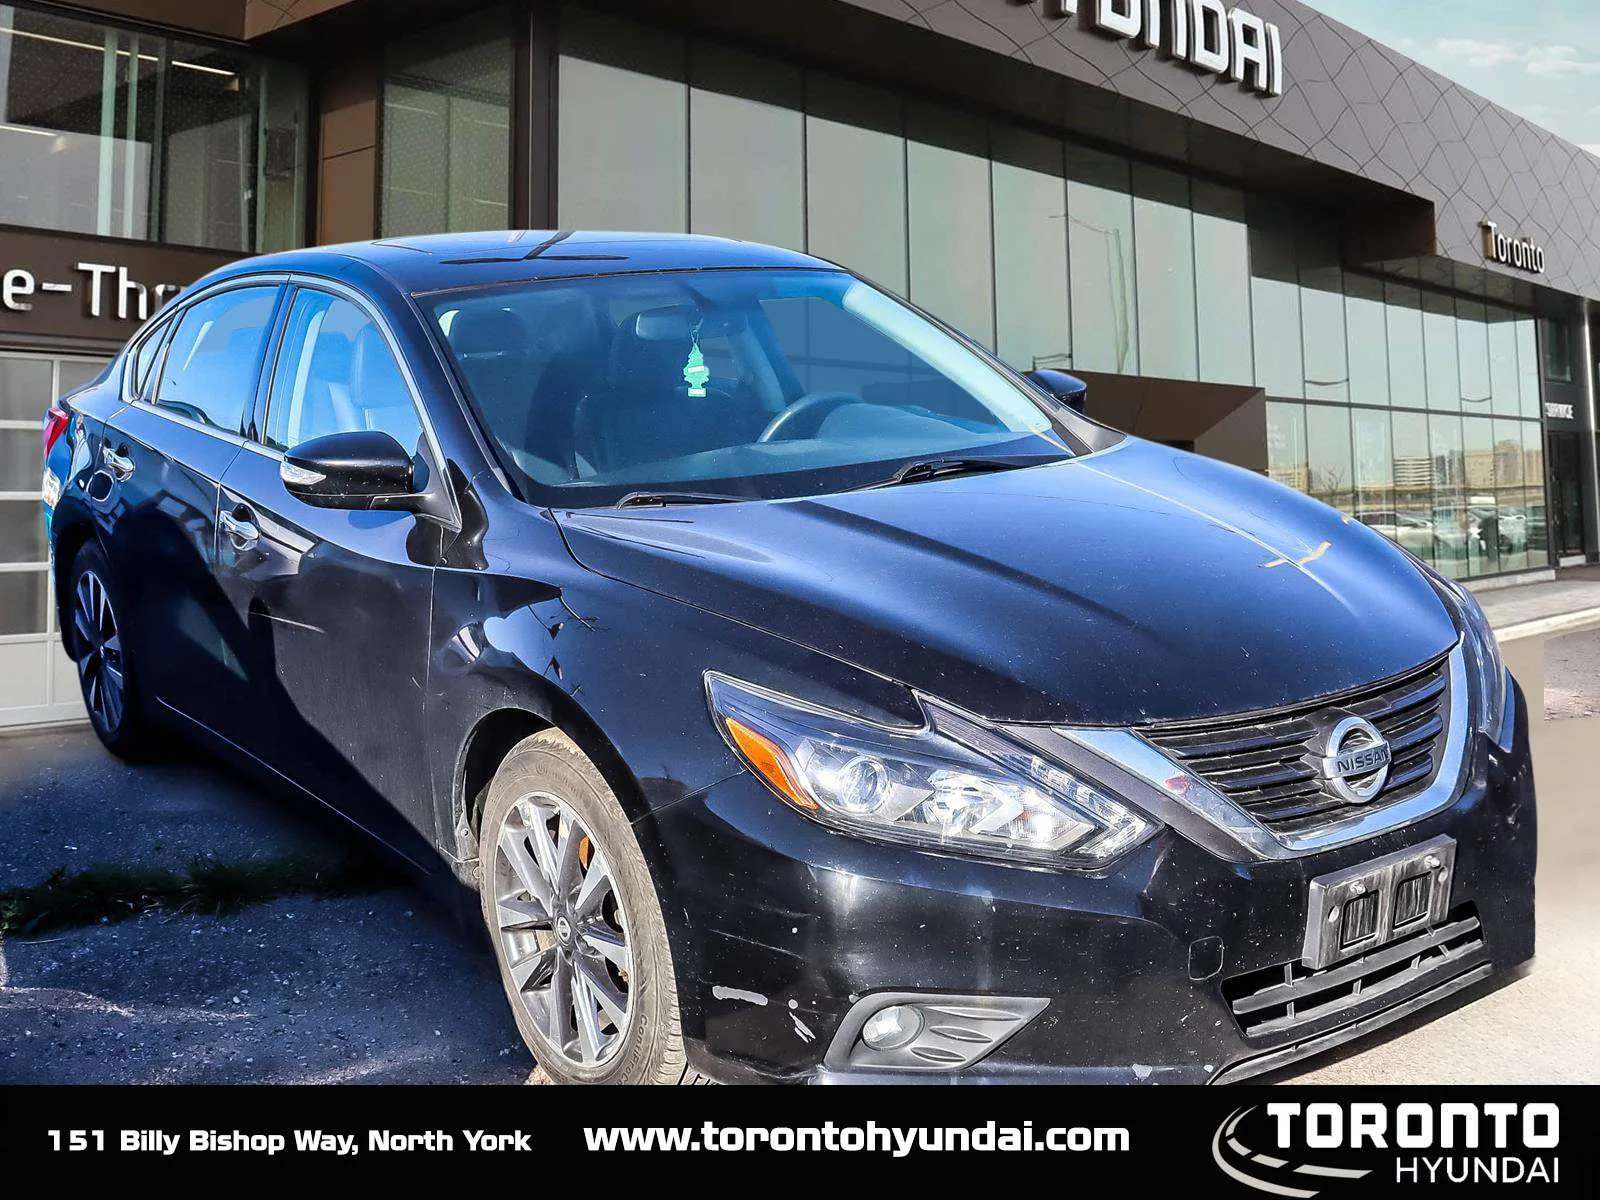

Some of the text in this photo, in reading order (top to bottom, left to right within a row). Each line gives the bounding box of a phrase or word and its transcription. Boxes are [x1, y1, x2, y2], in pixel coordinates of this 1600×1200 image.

[1483, 219, 1545, 273] Toronto
[3, 262, 189, 321] e-Thr
[1337, 748, 1390, 773] NISSAN
